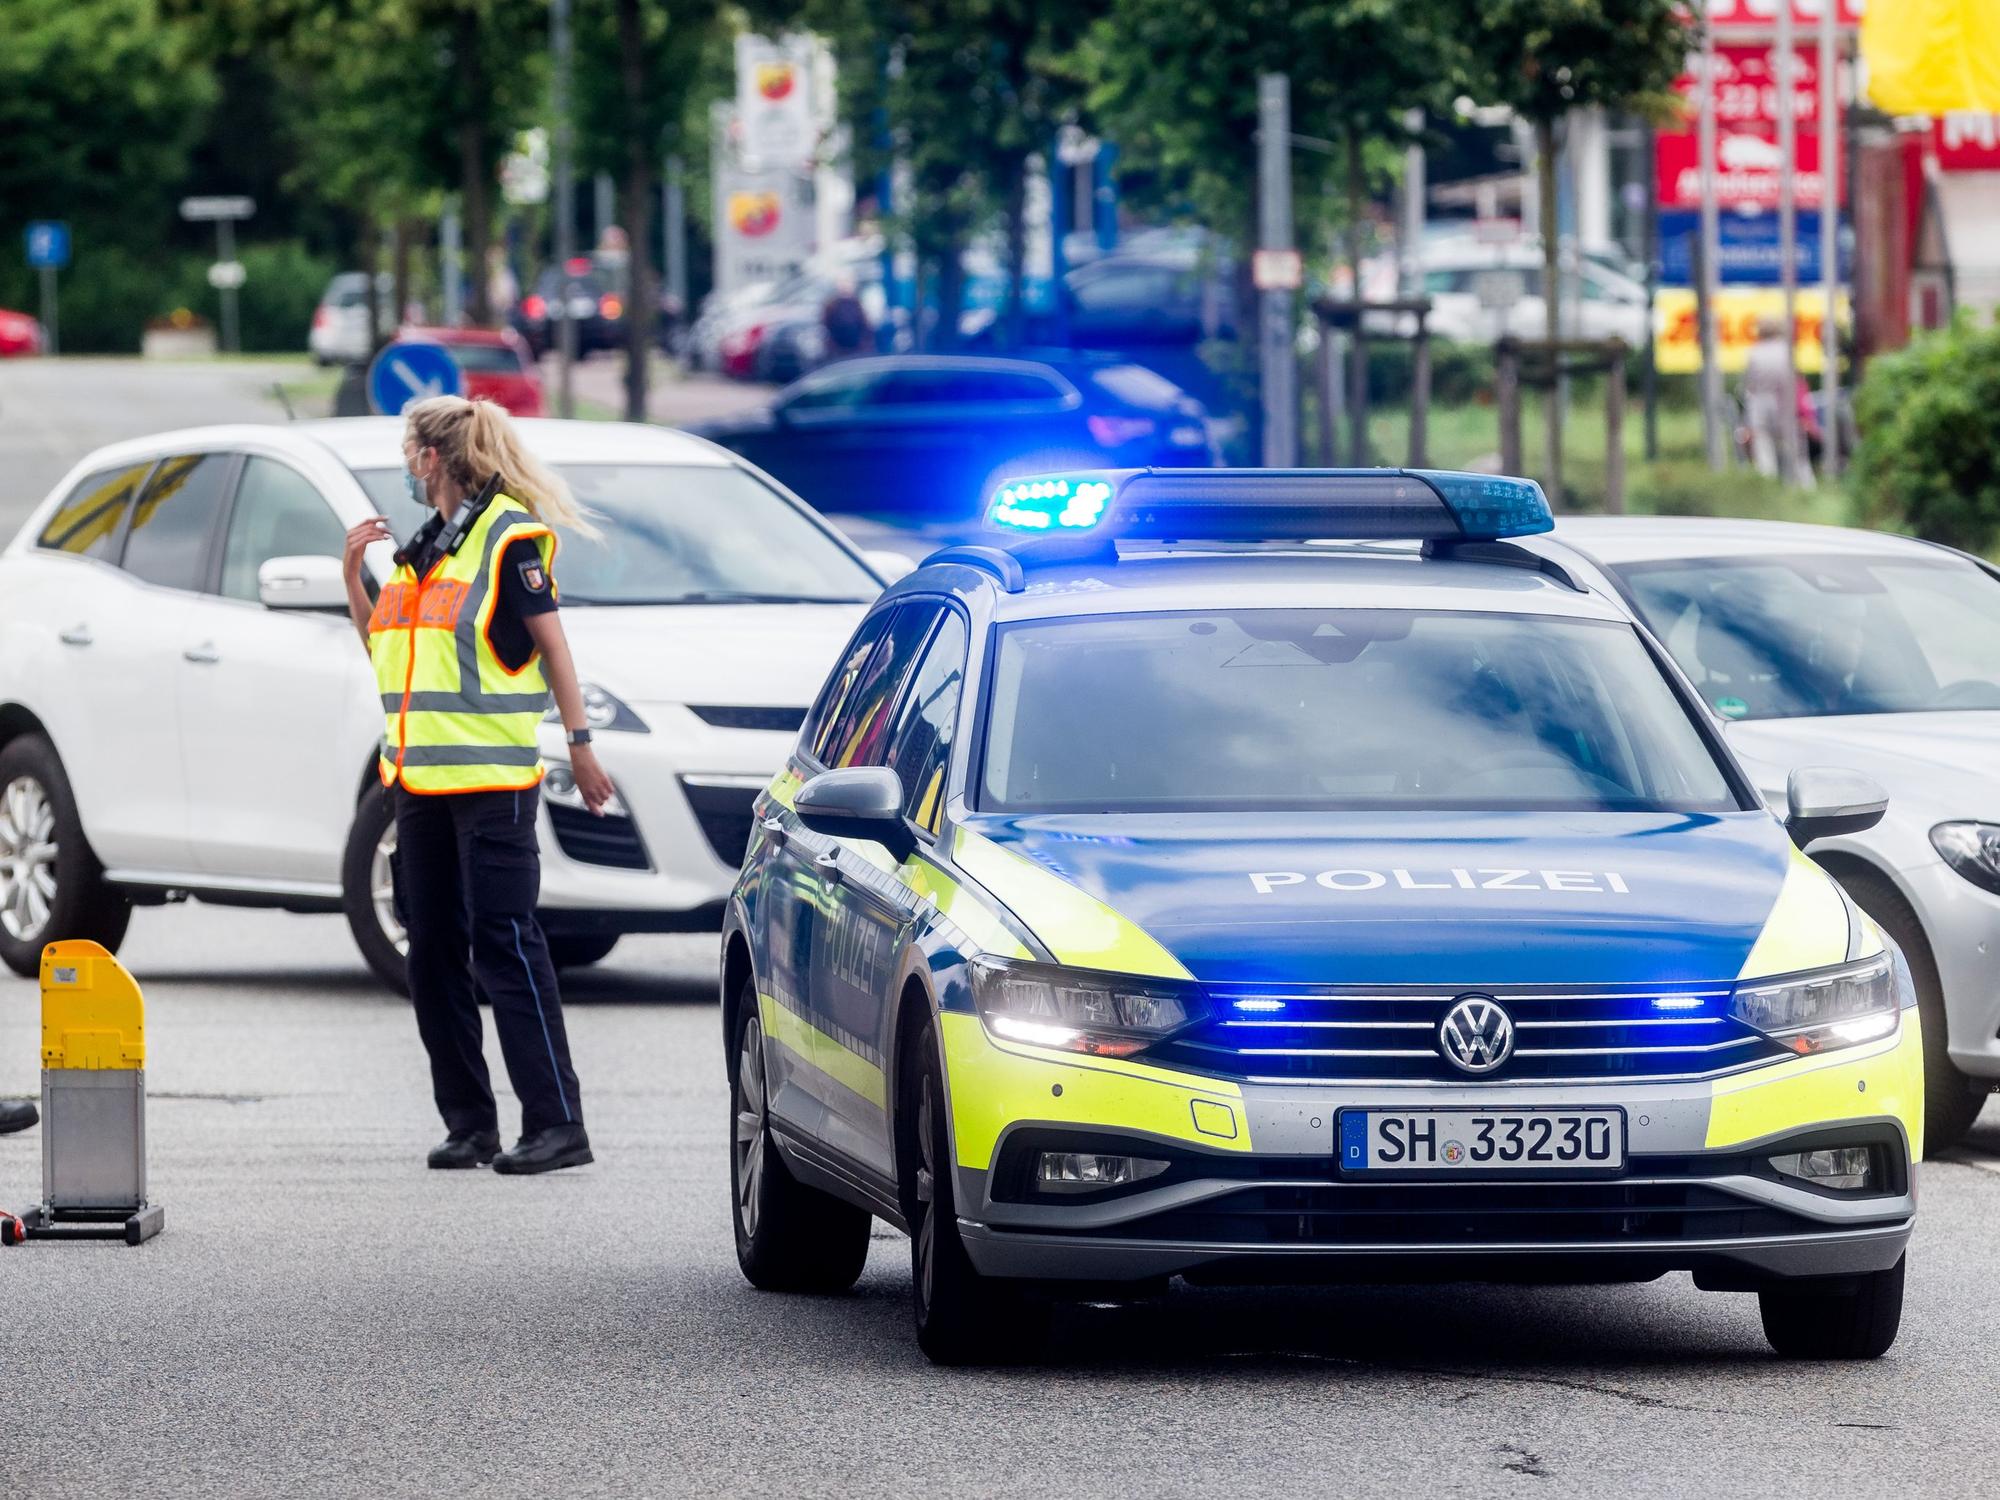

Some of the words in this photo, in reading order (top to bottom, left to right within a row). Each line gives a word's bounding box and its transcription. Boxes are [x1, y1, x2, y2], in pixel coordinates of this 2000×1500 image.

[1248, 868, 1630, 894] POLIZEI
[822, 904, 881, 996] POLIZEI
[1349, 1145, 1361, 1159] D
[1377, 1117, 1437, 1163] SH
[1469, 1116, 1611, 1162] 33230
